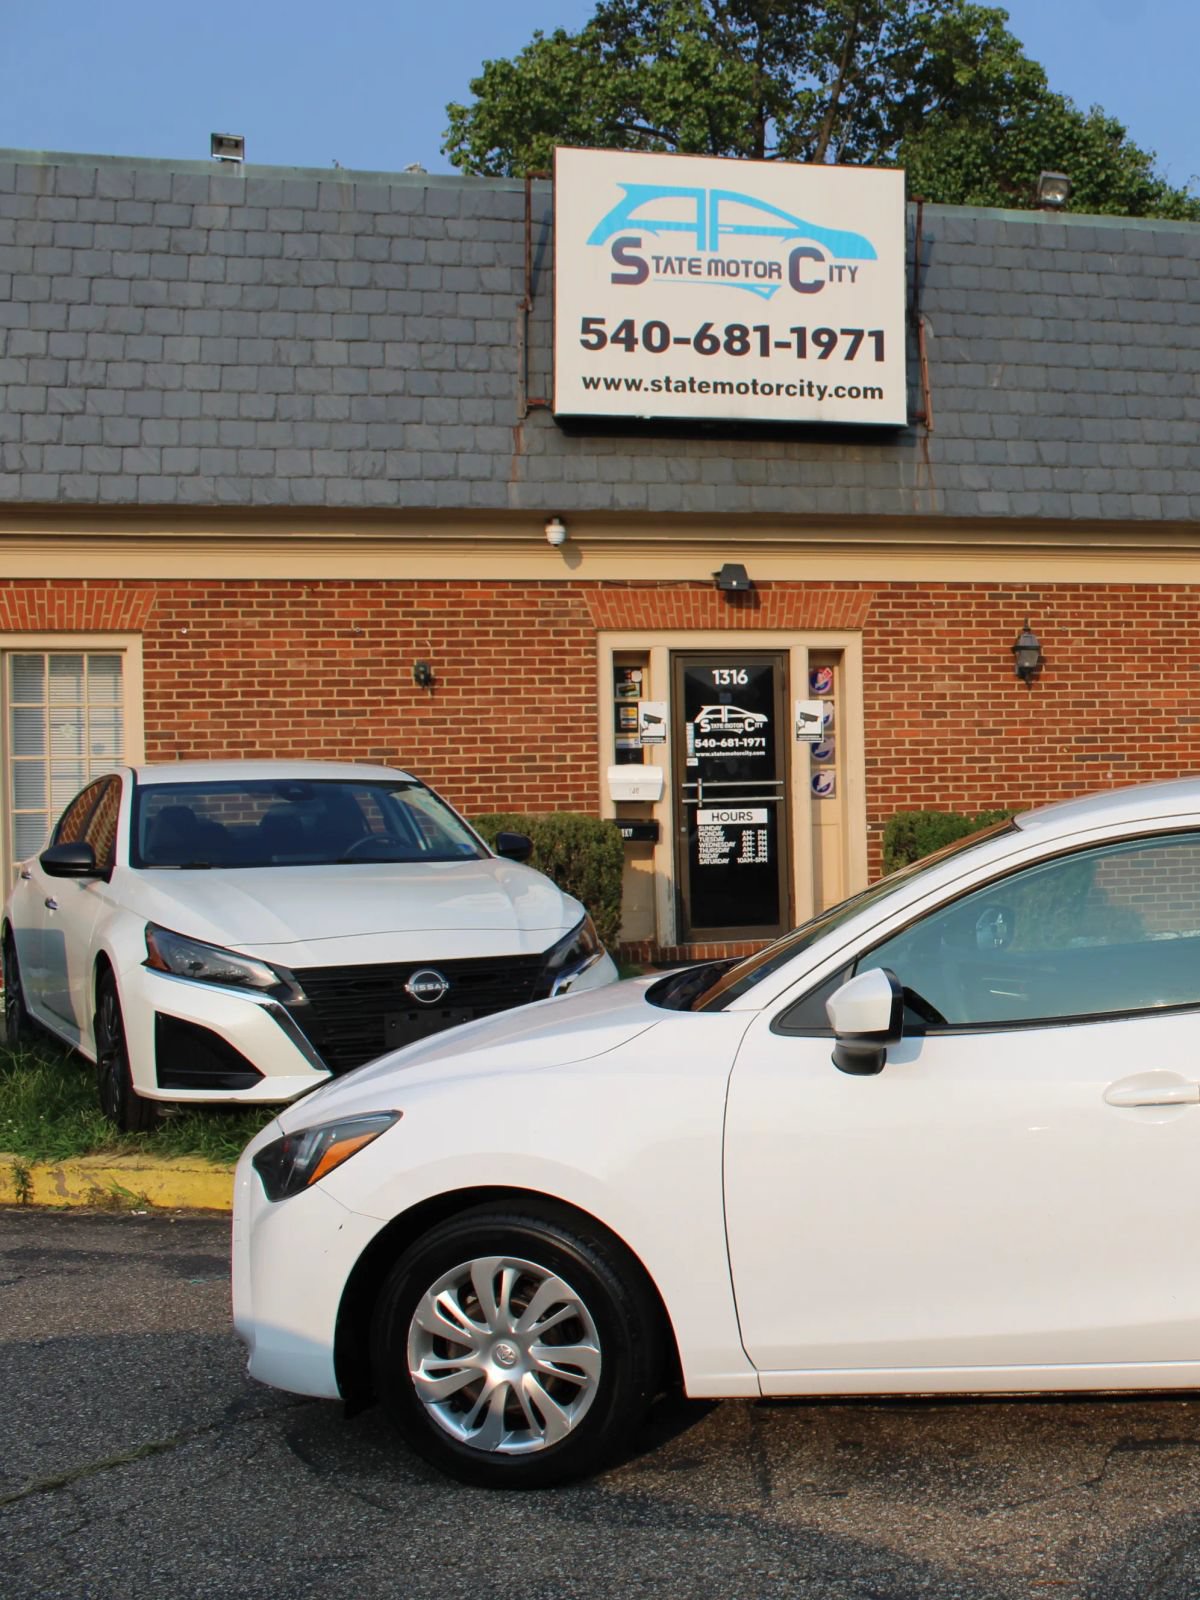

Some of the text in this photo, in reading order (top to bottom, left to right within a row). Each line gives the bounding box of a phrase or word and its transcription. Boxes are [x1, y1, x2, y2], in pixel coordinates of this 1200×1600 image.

[610, 236, 859, 294] STATE MOTOR CITY
[579, 316, 885, 362] 540-681-1971
[582, 375, 884, 401] www.statemotorcity.com
[712, 669, 749, 685] 1316
[700, 718, 723, 733] STATE
[744, 718, 764, 732] CITY
[694, 737, 766, 748] 540-681-1971
[711, 811, 753, 822] HOURS
[404, 982, 449, 992] NISSAN
